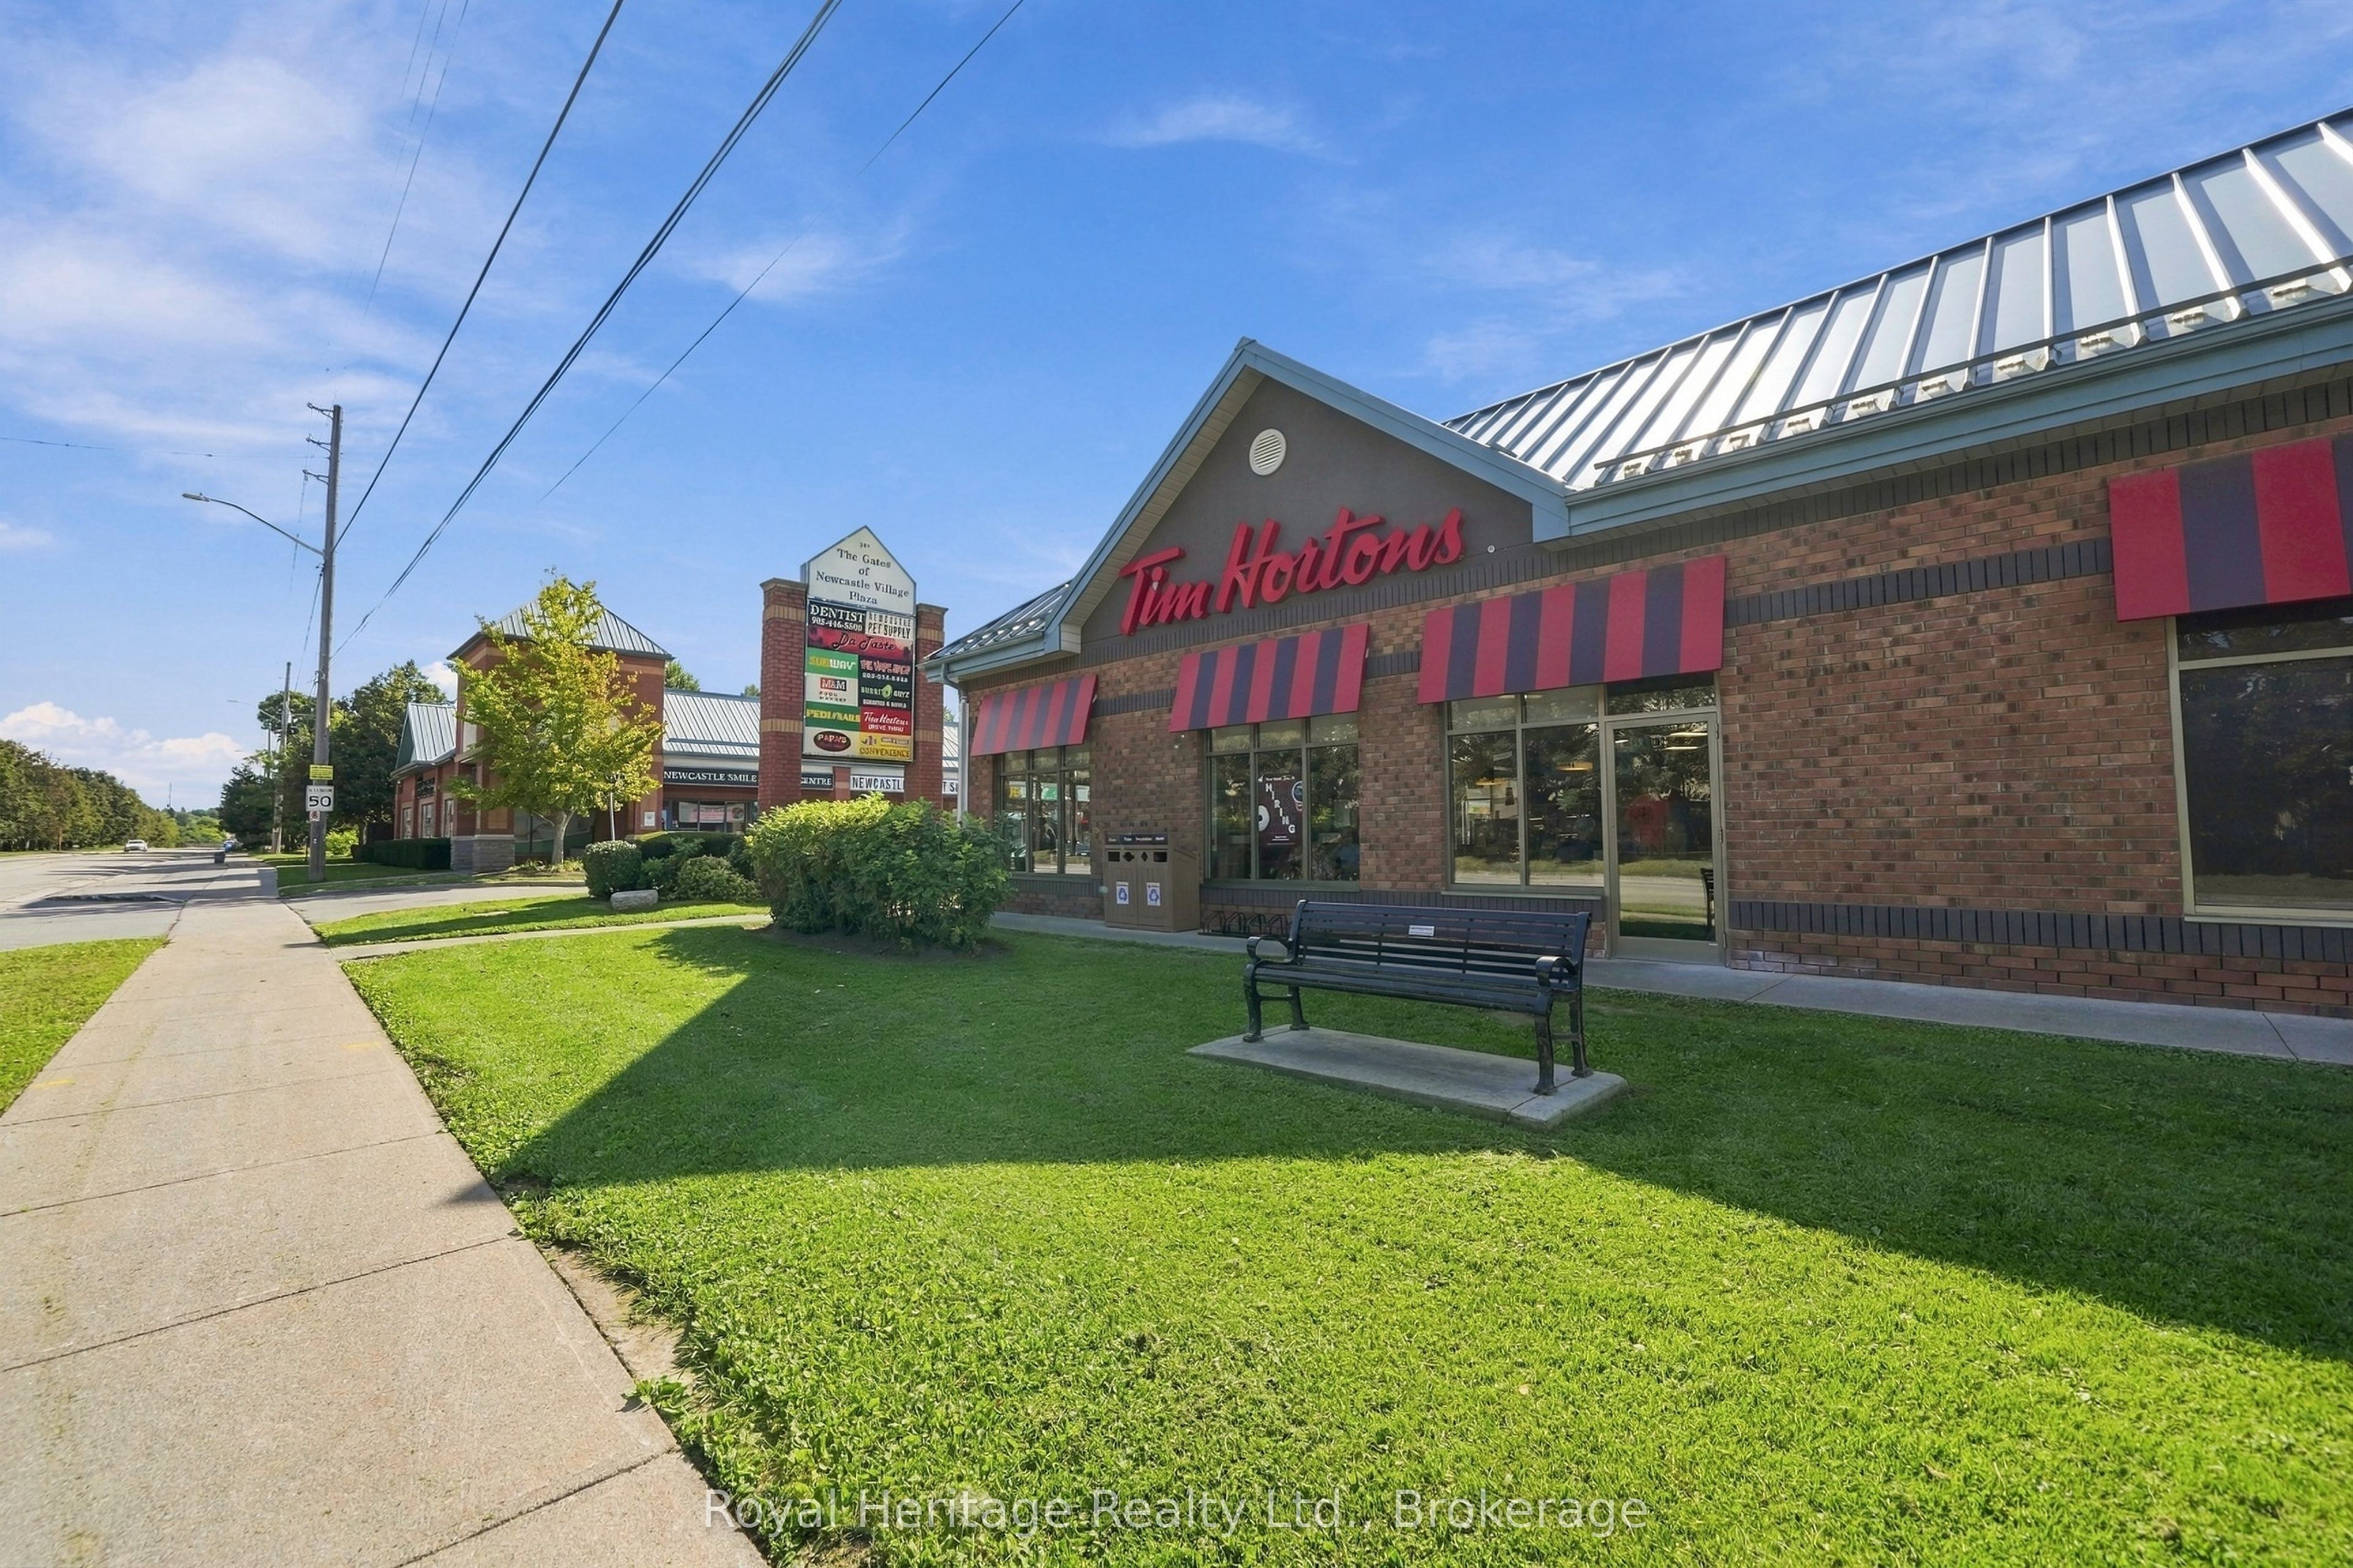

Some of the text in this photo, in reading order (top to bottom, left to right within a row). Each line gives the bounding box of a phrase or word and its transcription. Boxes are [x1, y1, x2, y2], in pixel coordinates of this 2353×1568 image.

[837, 548, 891, 568] The Gates
[858, 567, 870, 576] of
[1119, 506, 1466, 637] Tim Hortons
[816, 570, 909, 597] Newcastle Village
[849, 591, 877, 604] Plaza
[810, 604, 865, 623] DENTIST
[869, 612, 911, 627] NEWCASTLE
[868, 622, 911, 639] PET SUPPLY
[832, 634, 896, 651] Da Taste
[809, 656, 856, 670] SUBWAY
[822, 679, 846, 691] M&M
[893, 690, 910, 699] GUYZ
[864, 711, 909, 725] Tim Hortons
[817, 734, 847, 743] PAPA'S
[860, 747, 910, 758] CONVENIENCE
[664, 771, 726, 781] NEWCASTLE
[852, 777, 904, 790] NEWCASTL
[309, 796, 331, 807] 50
